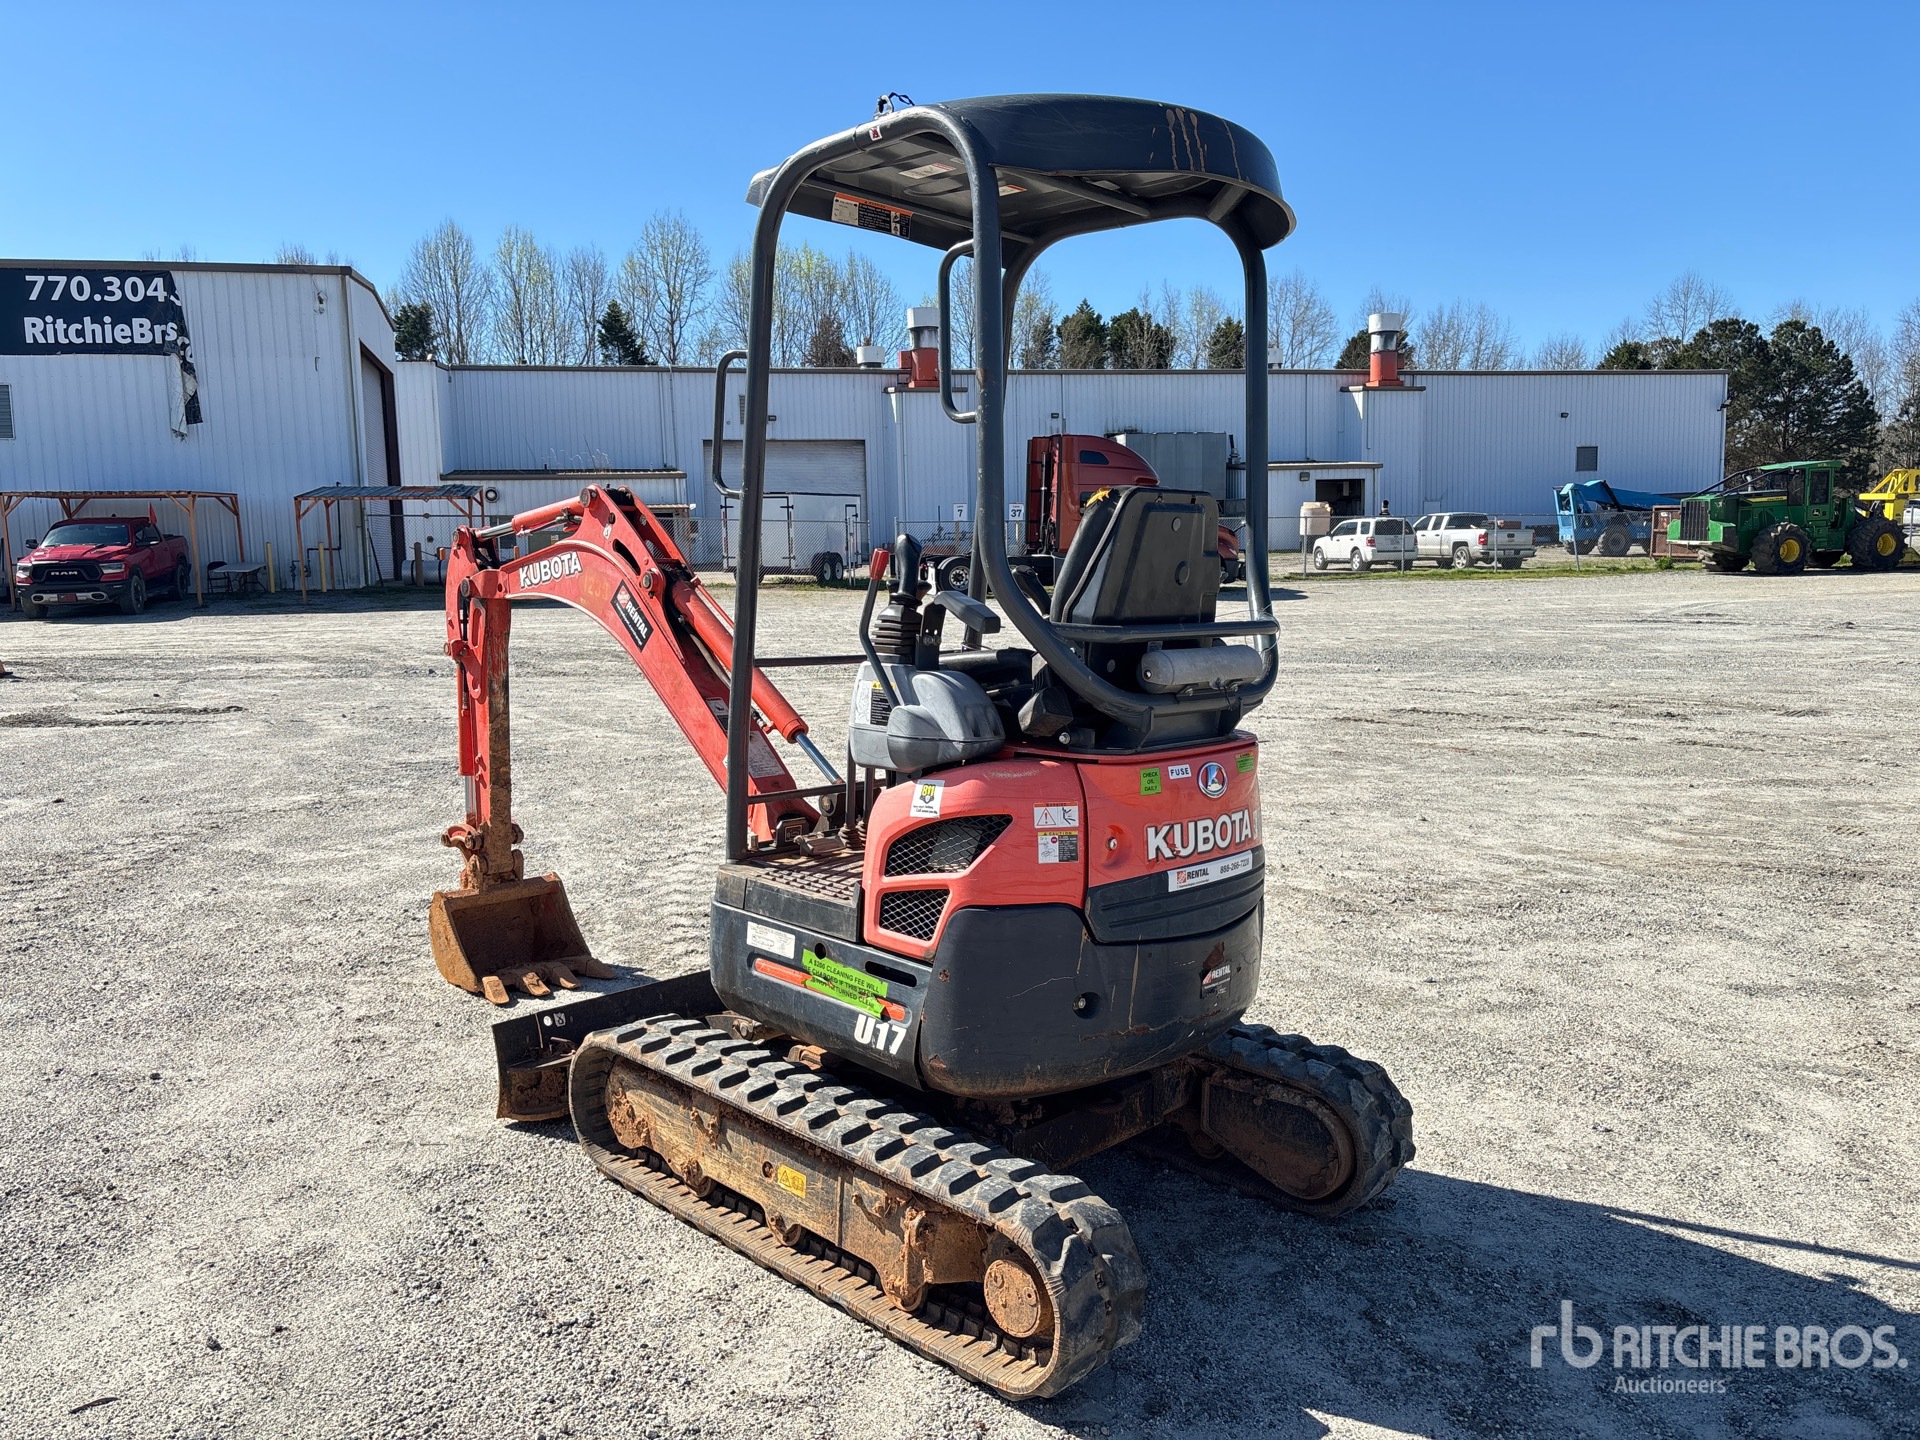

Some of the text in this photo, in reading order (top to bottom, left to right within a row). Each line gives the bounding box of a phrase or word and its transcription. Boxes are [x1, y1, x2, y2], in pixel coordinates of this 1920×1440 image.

[957, 509, 963, 518] 7
[1010, 509, 1022, 518] 37
[519, 551, 582, 588] KUBOTA
[626, 601, 648, 639] RENTAL
[1170, 767, 1190, 776] FUSE
[1147, 809, 1251, 861] KUBOTA
[1187, 868, 1209, 880] RENTAL
[826, 965, 854, 982] CLEANING
[854, 977, 866, 987] FEE
[866, 982, 880, 993] WILL
[853, 1013, 908, 1055] U17
